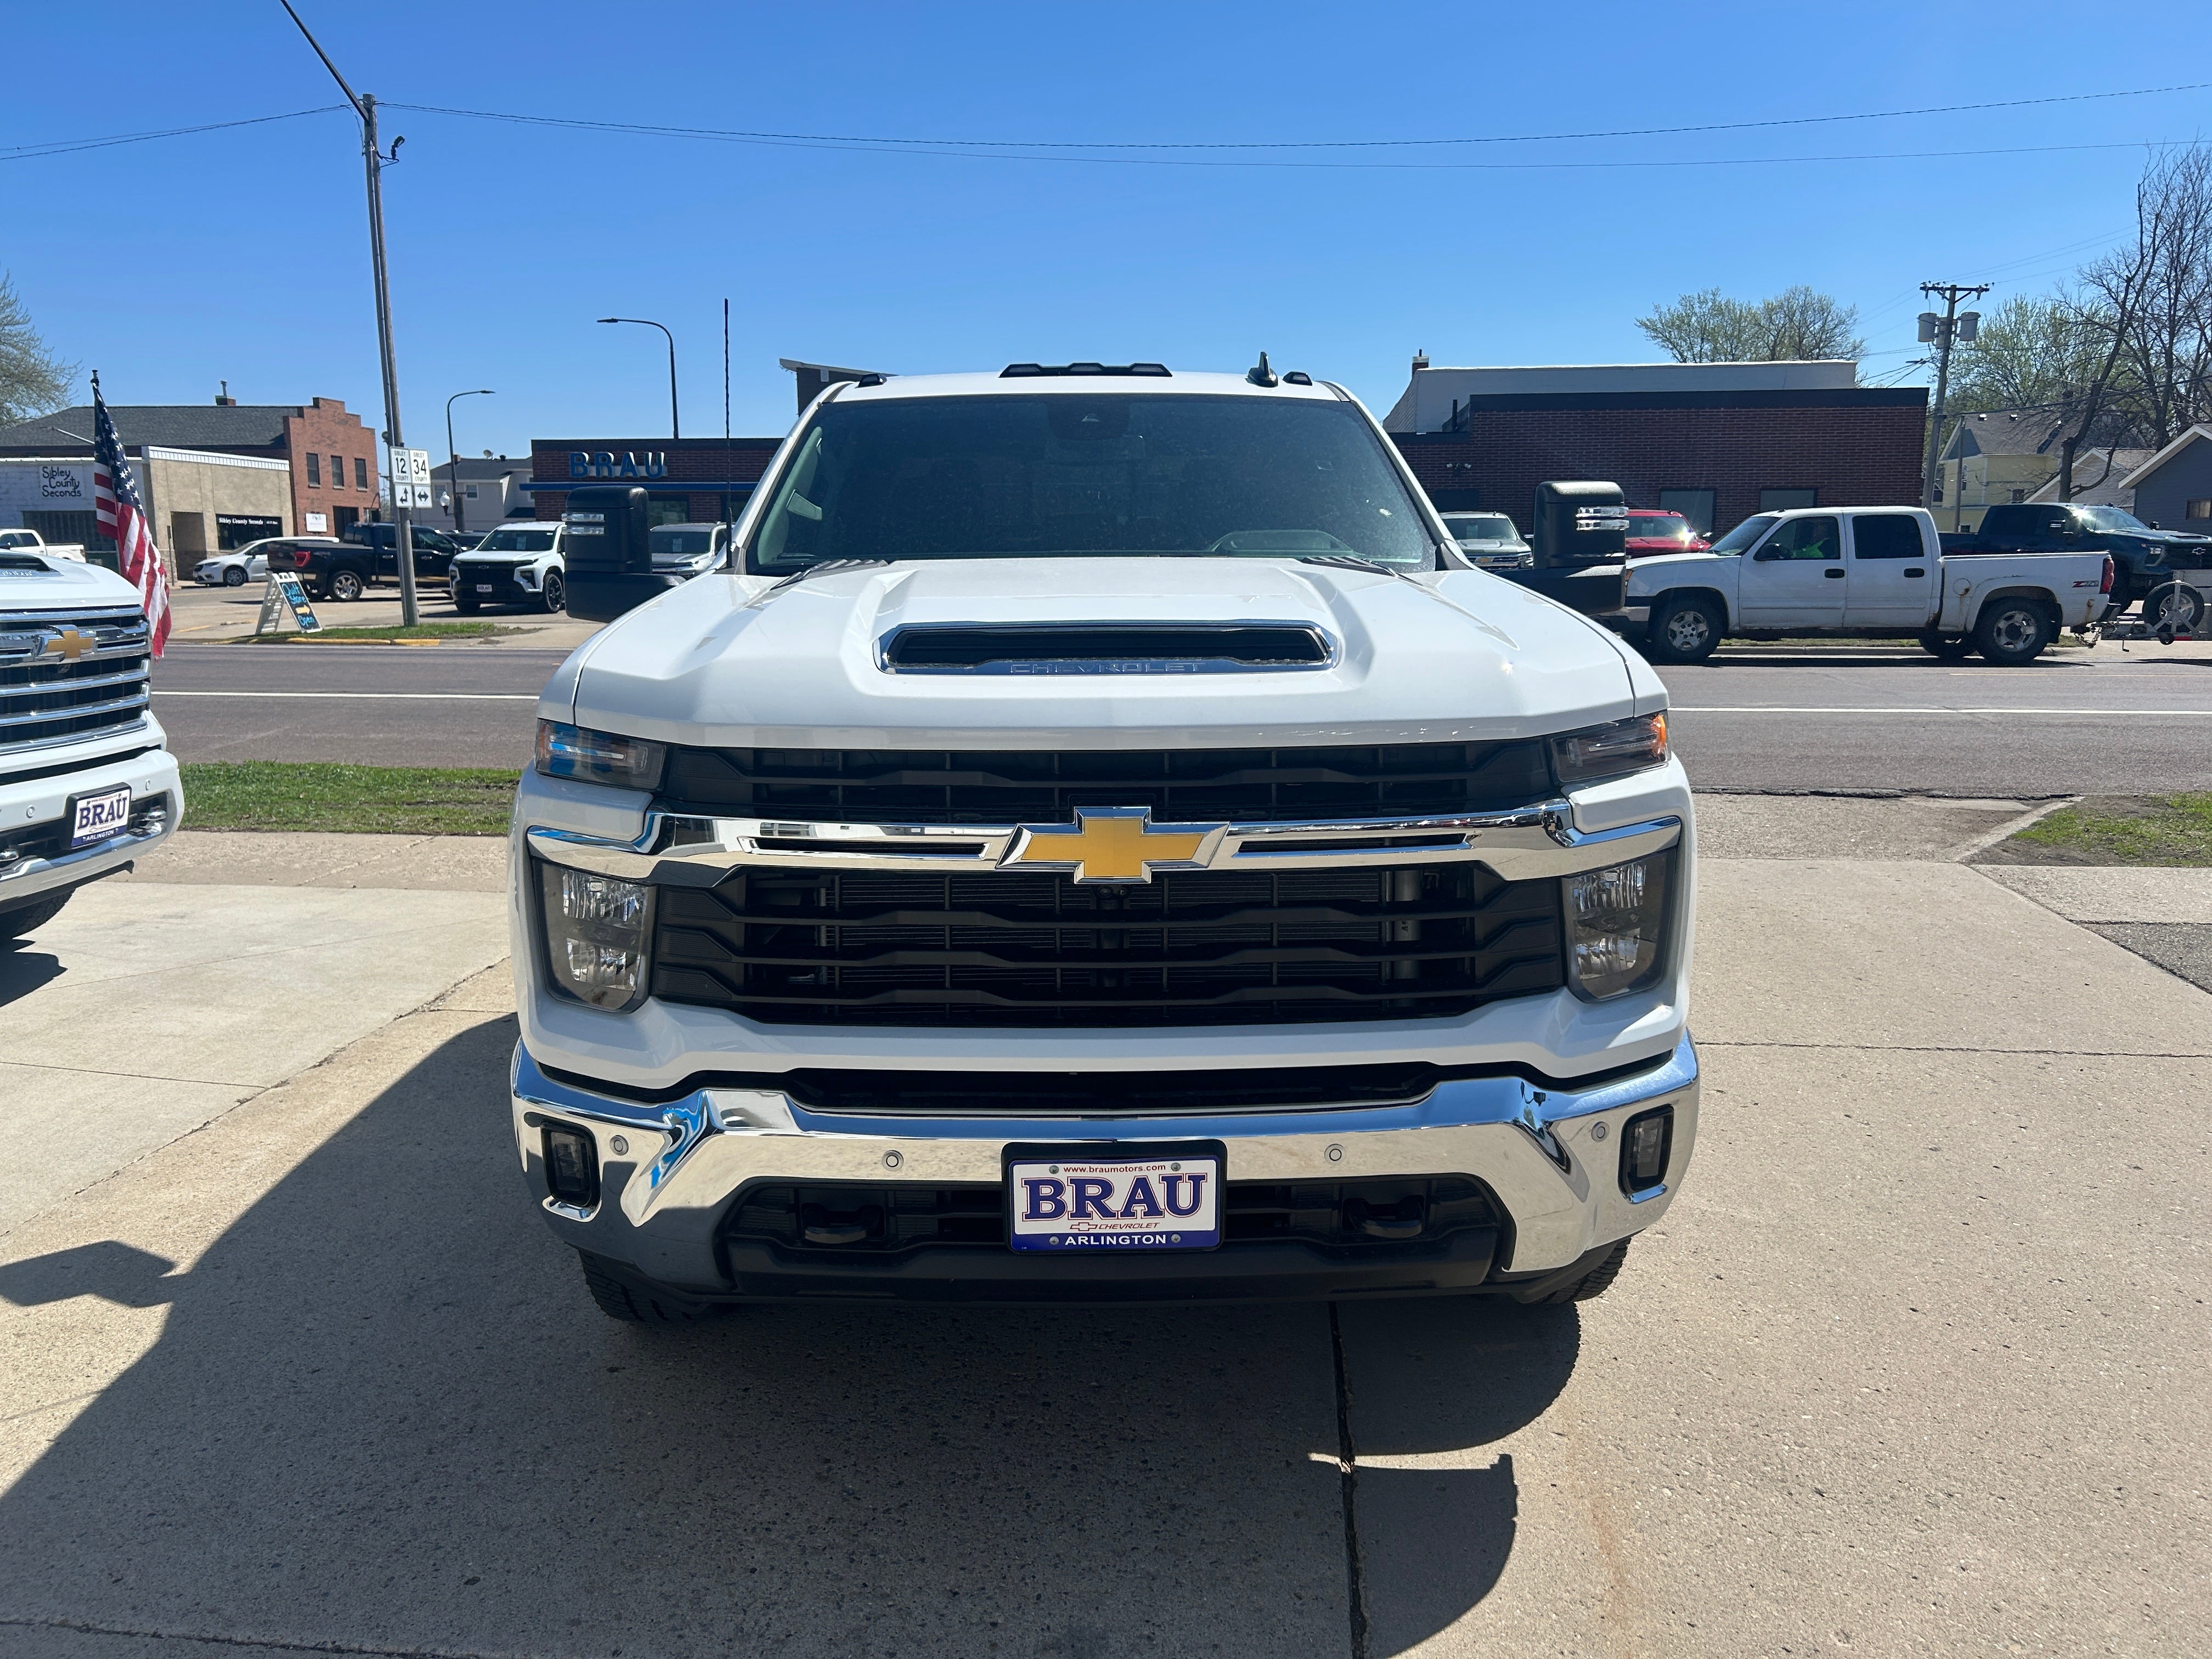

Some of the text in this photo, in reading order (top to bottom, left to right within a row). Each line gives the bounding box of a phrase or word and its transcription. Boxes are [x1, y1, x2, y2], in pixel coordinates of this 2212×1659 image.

[396, 457, 407, 473] 12
[413, 459, 427, 475] 34
[569, 452, 665, 479] BRAU
[42, 466, 71, 480] Sibley
[49, 476, 80, 489] County
[42, 484, 82, 497] Seconds
[1011, 662, 1206, 673] CHEVROLET
[77, 797, 127, 831] BRAU
[86, 830, 114, 841] ARLINGTON
[1063, 1164, 1166, 1173] www.braumotors.com
[1021, 1172, 1207, 1222] BRAU
[1064, 1234, 1166, 1245] ARLINGTON
